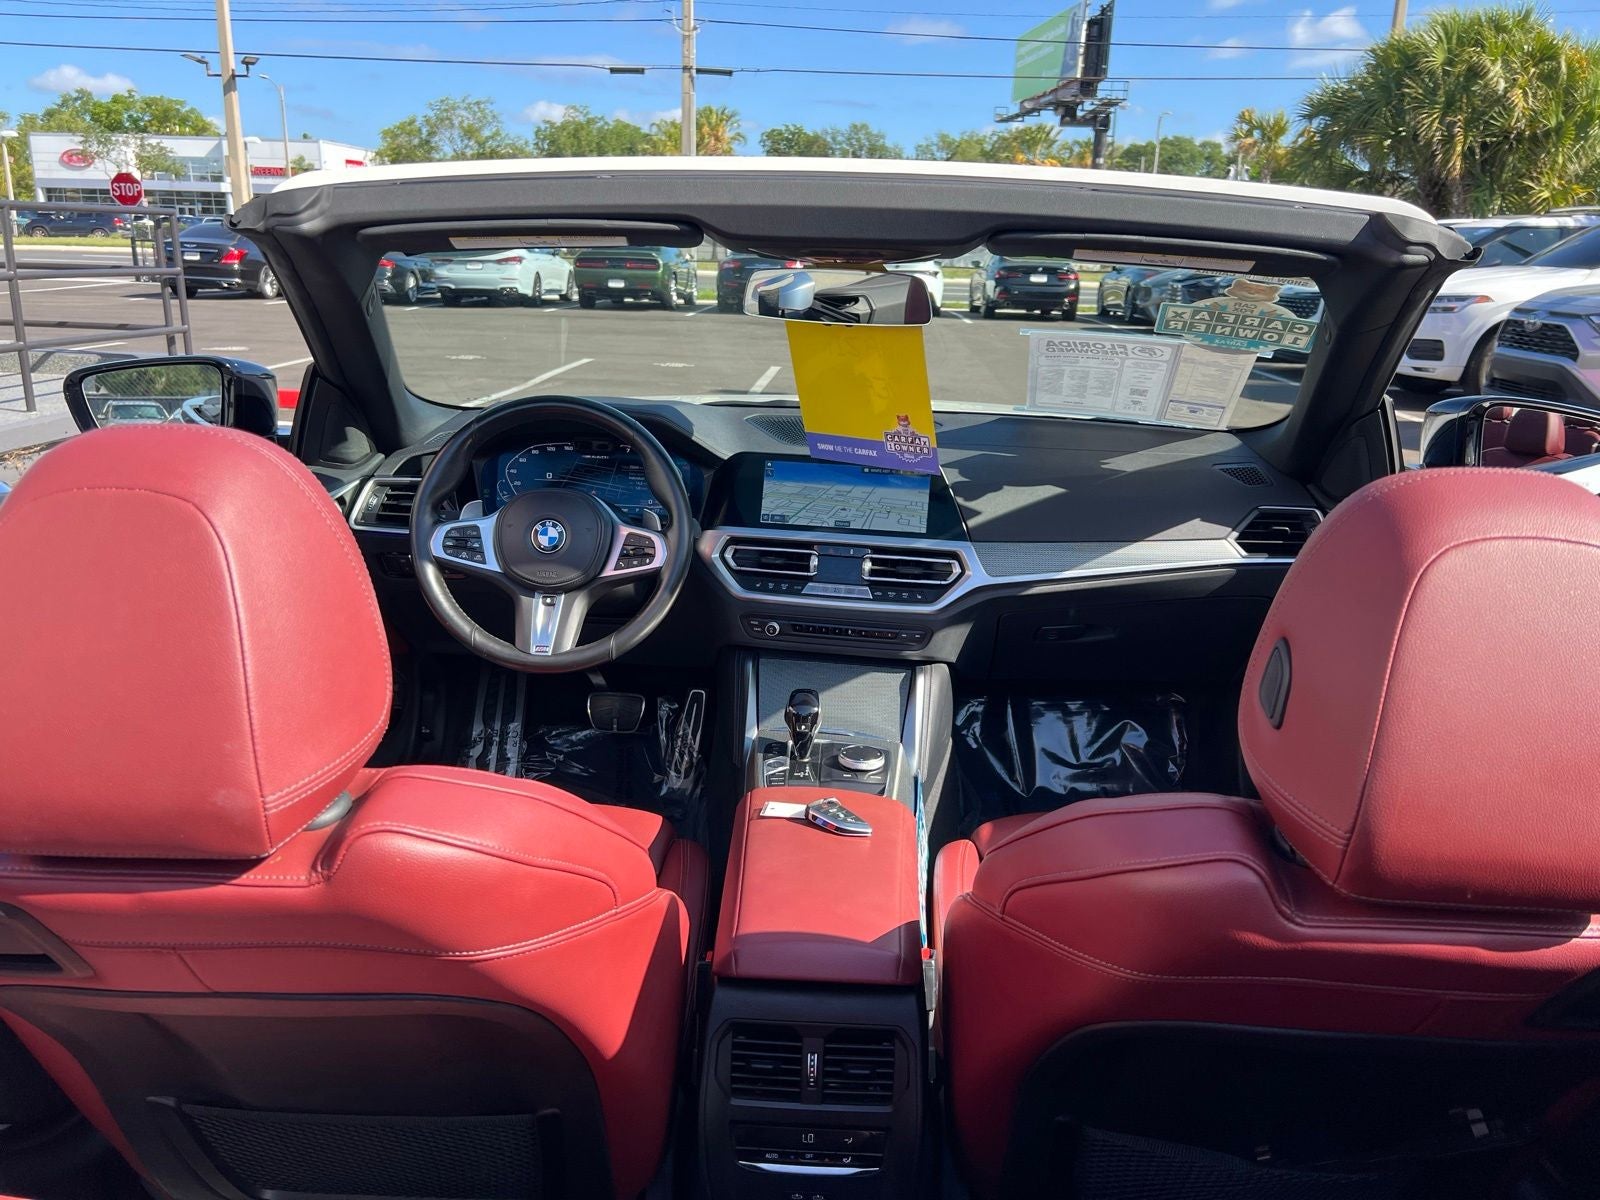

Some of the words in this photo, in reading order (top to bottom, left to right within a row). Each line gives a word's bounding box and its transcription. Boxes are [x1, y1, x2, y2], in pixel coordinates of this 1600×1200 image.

[112, 182, 142, 197] STOP
[886, 434, 928, 446] CARFAX
[816, 443, 834, 452] SHOW
[834, 445, 843, 453] ME
[843, 446, 854, 454] THE
[854, 447, 878, 457] CARFAX
[895, 444, 929, 455] OWNER
[537, 521, 562, 533] BMW
[802, 1133, 814, 1143] LO
